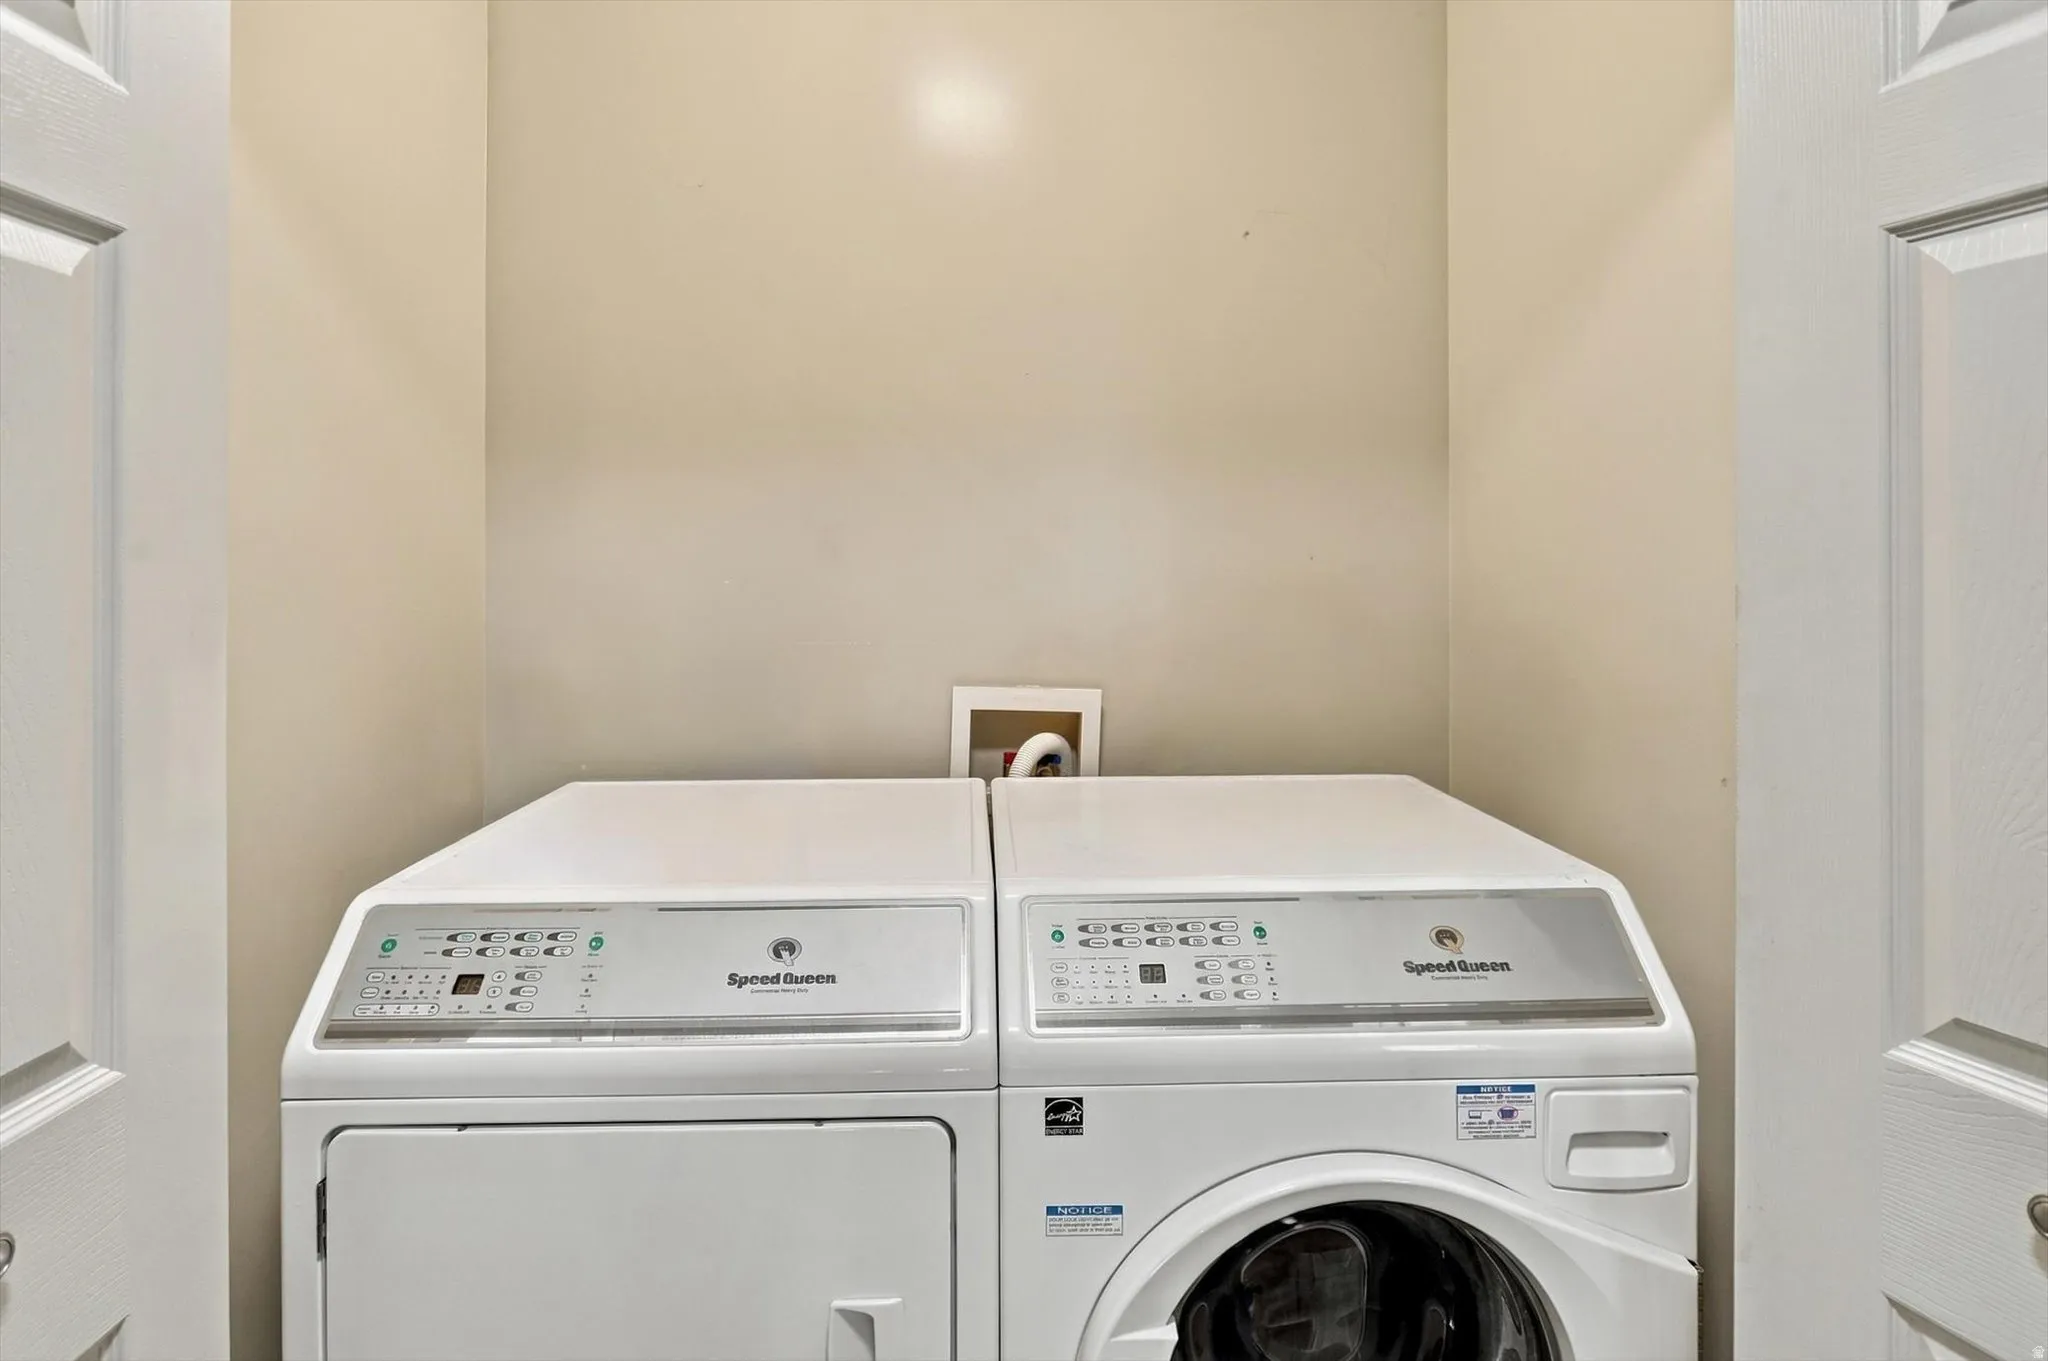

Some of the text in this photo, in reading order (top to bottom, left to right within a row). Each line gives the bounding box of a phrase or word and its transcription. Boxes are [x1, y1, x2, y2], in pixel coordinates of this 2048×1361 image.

[1403, 959, 1512, 976] Speed Queen
[727, 972, 837, 988] Speed Queen
[1045, 1127, 1084, 1135] ENERGY STAR
[1057, 1206, 1112, 1215] NOTICE
